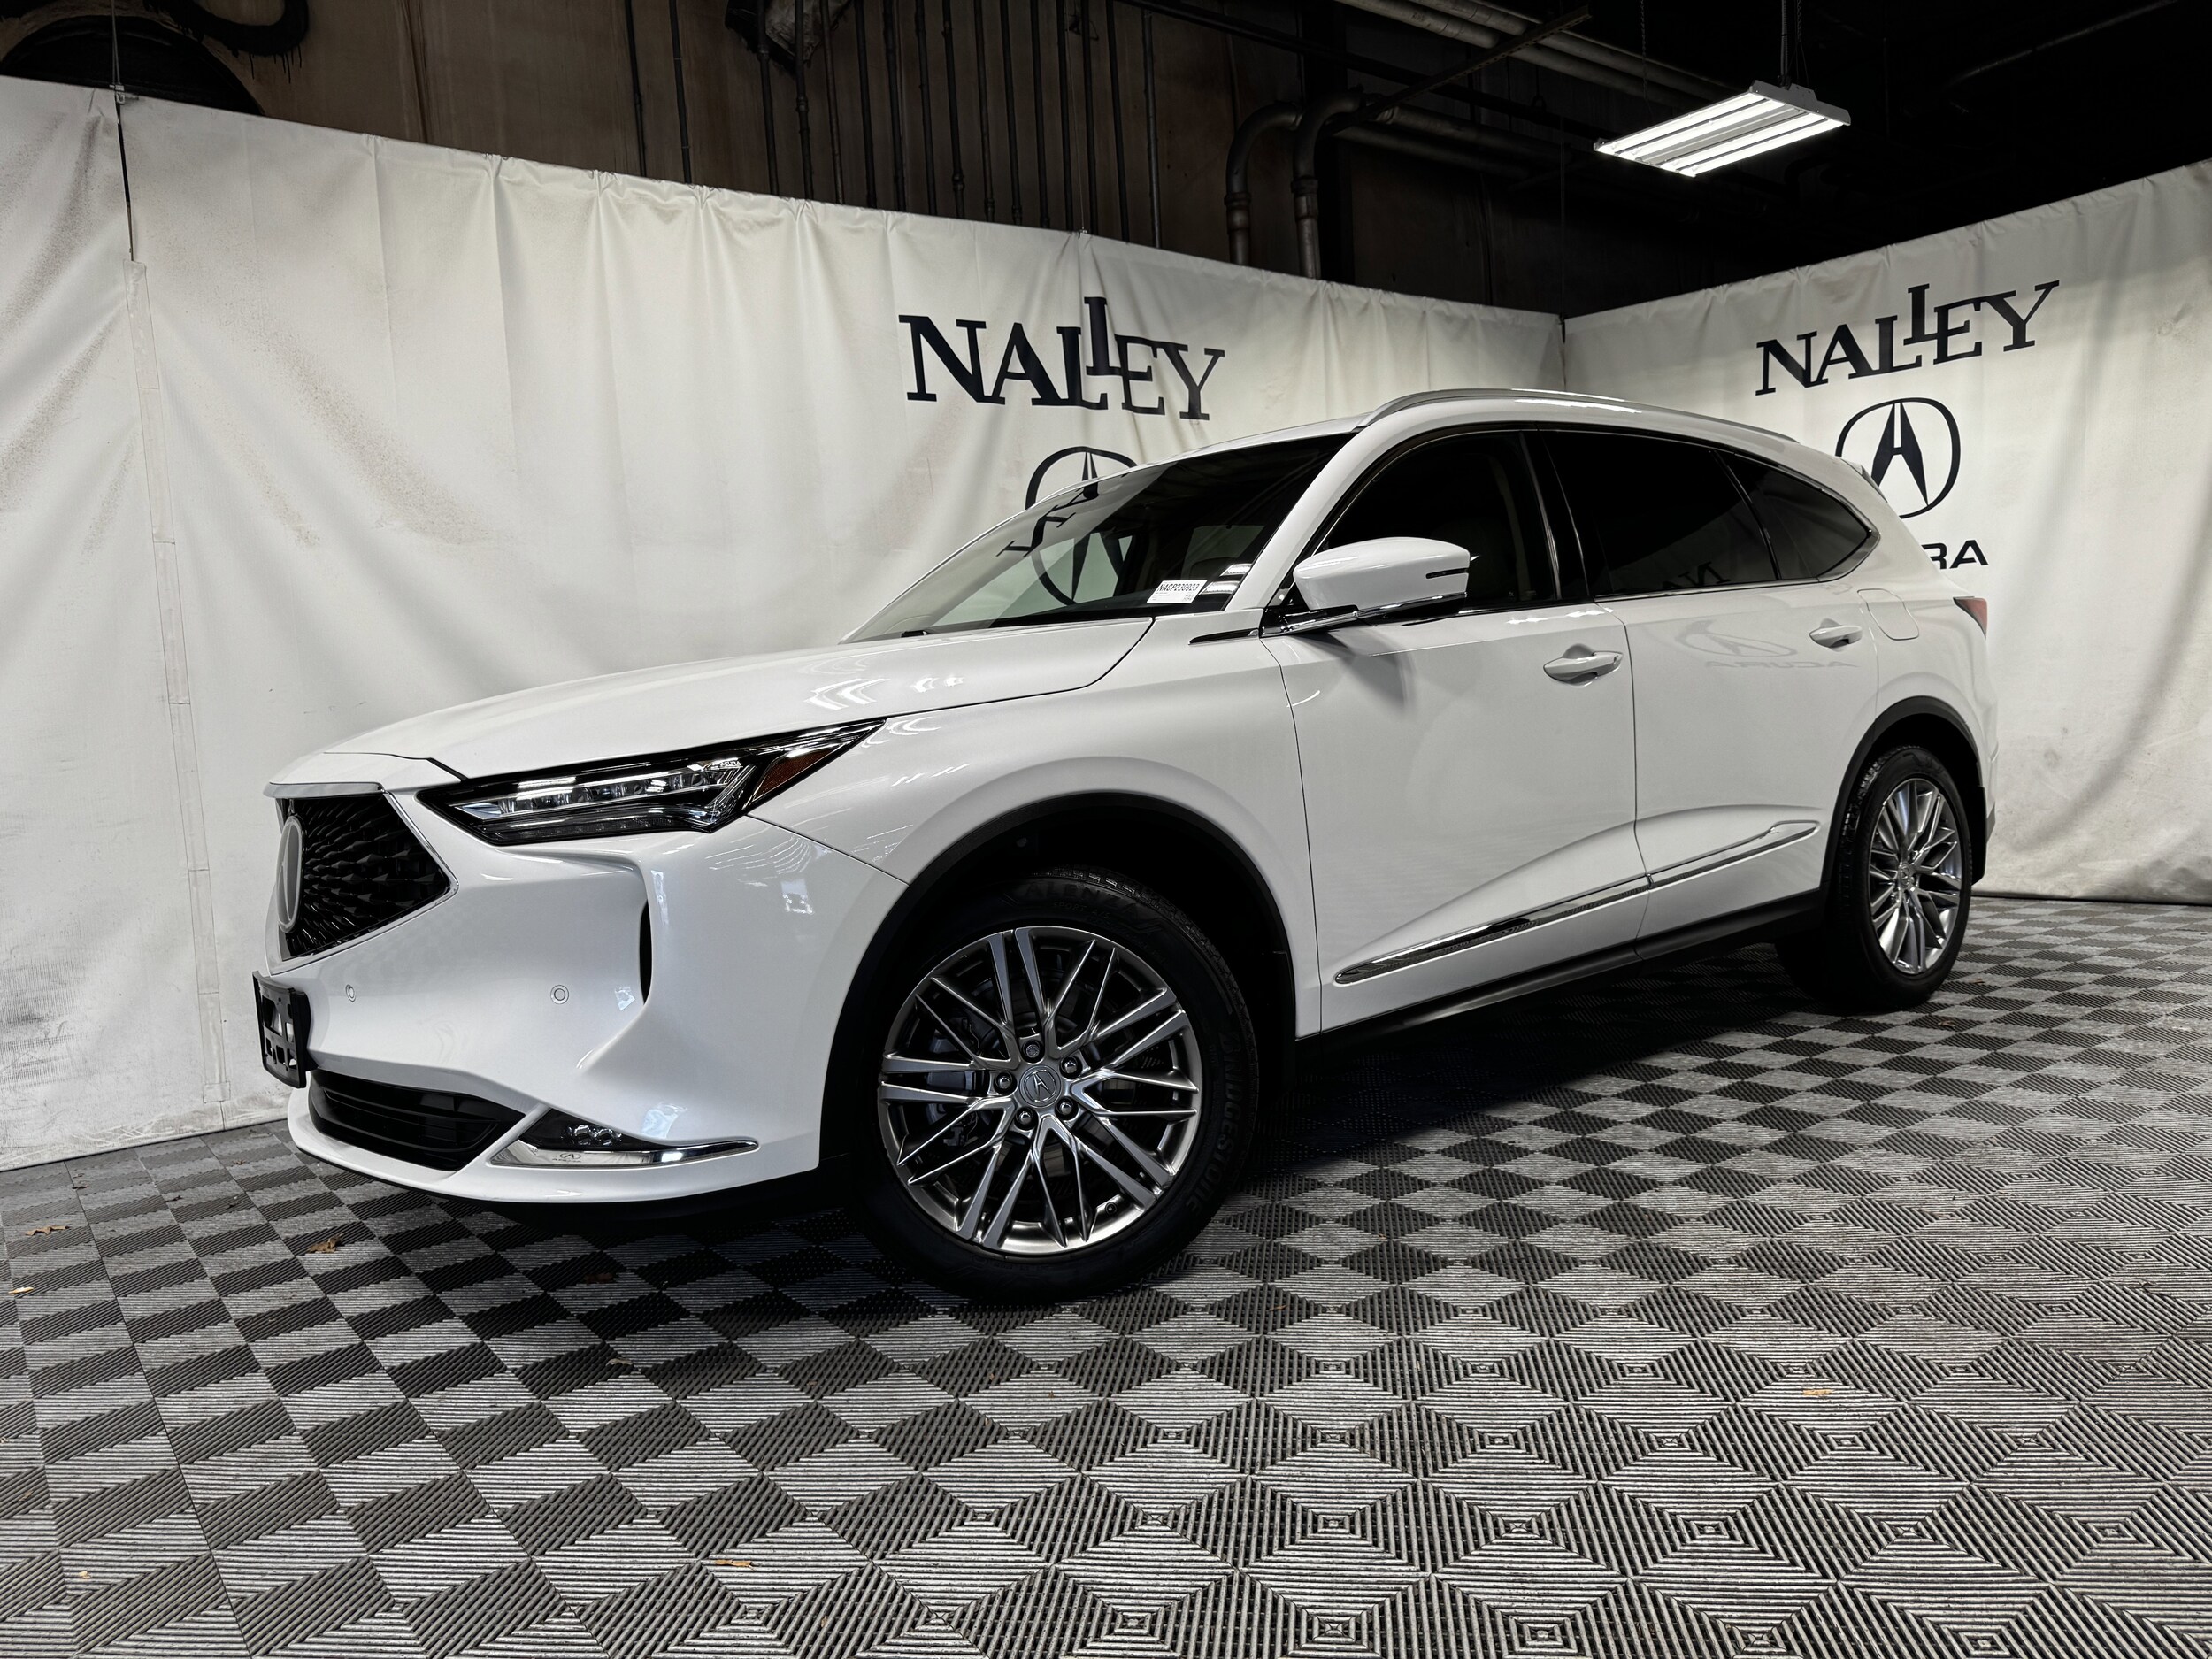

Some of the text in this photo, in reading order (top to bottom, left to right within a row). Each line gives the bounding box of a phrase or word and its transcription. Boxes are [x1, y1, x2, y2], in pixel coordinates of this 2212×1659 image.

[898, 296, 1225, 421] NALLEY
[1755, 280, 2060, 396] NALLEY
[1921, 539, 1989, 570] RA
